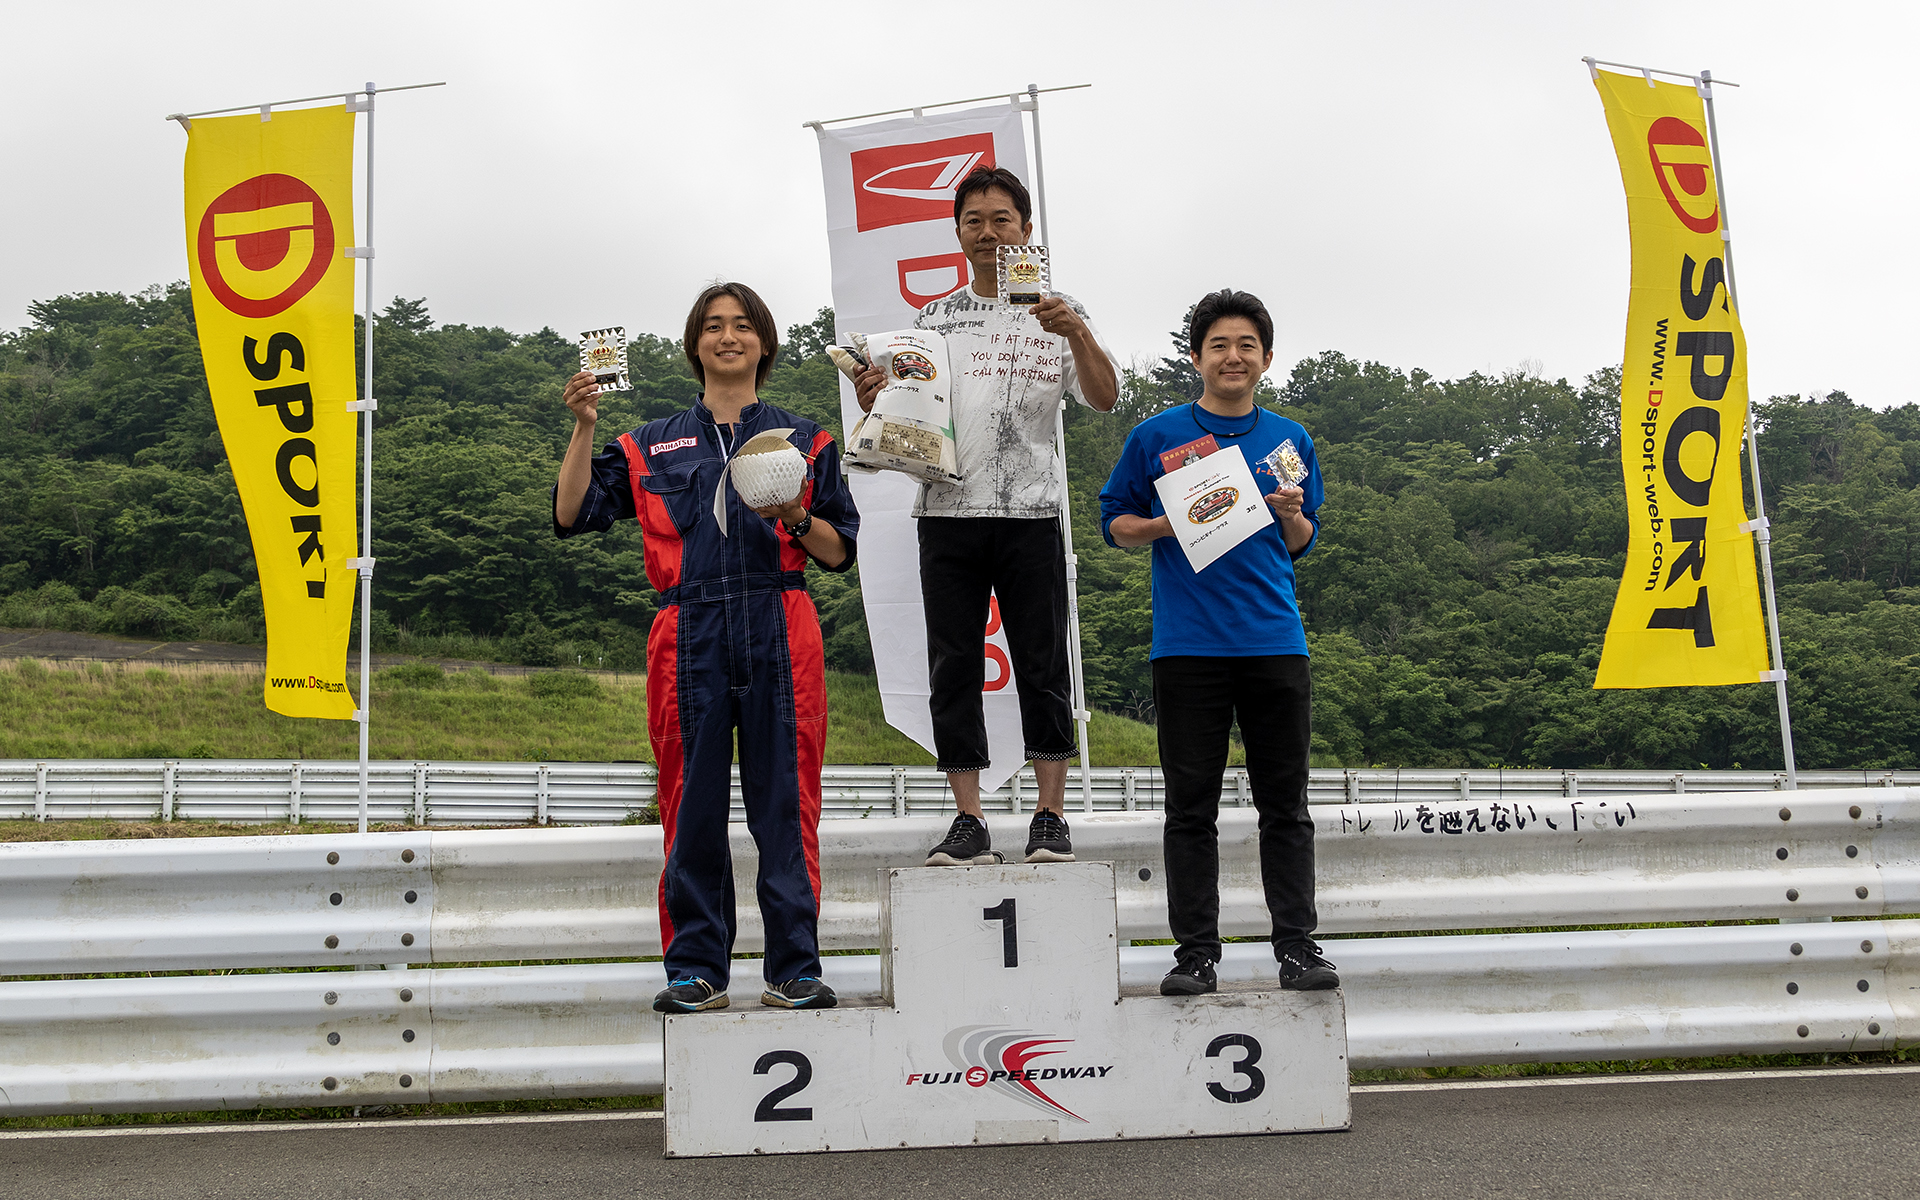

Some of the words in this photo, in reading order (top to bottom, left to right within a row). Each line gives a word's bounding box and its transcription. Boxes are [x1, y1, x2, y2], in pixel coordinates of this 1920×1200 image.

[207, 191, 322, 308] D
[968, 320, 986, 328] TIME
[990, 333, 1001, 345] IF
[1005, 333, 1020, 345] AT
[1024, 336, 1055, 350] FIRST
[971, 351, 992, 363] YOU
[998, 350, 1031, 363] DON'T
[972, 366, 992, 377] CALL
[996, 366, 1009, 377] AN
[1010, 368, 1061, 384] AIRSTRIKE
[654, 439, 693, 453] DAIHATSU
[1640, 318, 1670, 591] www.Dsport-web.com
[1646, 252, 1735, 648] SPORT
[982, 898, 1019, 969] 1
[752, 1049, 814, 1123] 2
[905, 1071, 962, 1086] FUJI
[966, 1065, 1114, 1086] SPEEDWAY
[1204, 1032, 1267, 1104] 3
